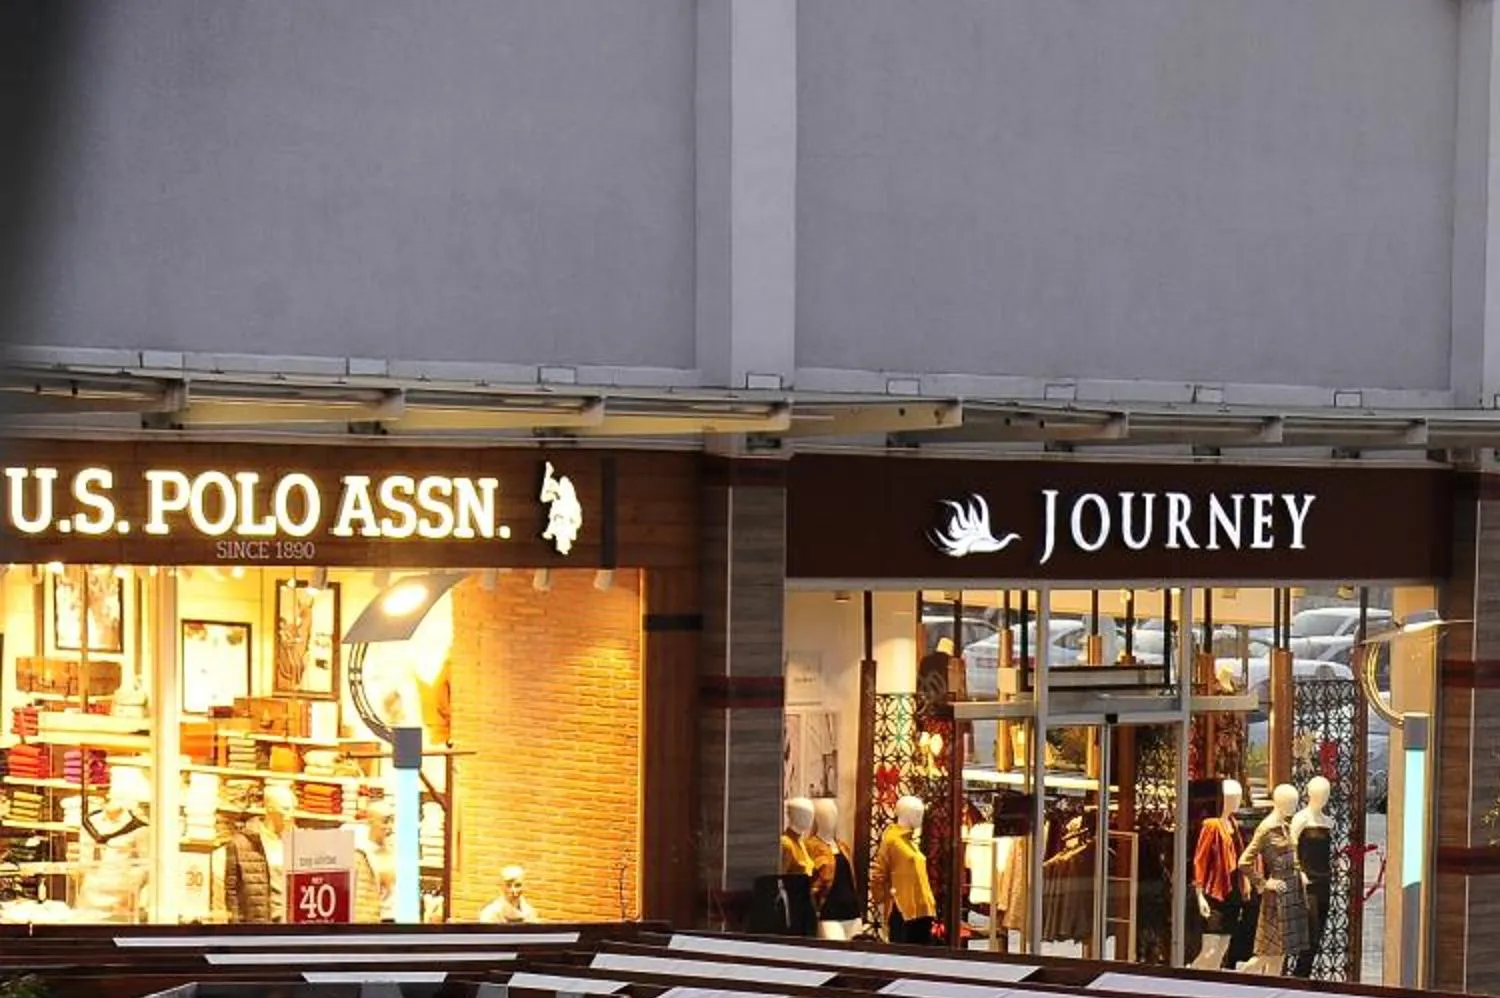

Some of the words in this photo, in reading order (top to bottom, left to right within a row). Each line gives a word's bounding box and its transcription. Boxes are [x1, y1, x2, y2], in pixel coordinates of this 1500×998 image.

[4, 466, 130, 534] U.S.
[145, 469, 321, 538] POLO
[329, 475, 511, 540] ASSN.
[1039, 489, 1317, 565] JOURNEY
[216, 541, 270, 559] SINCE
[275, 541, 316, 560] 1890
